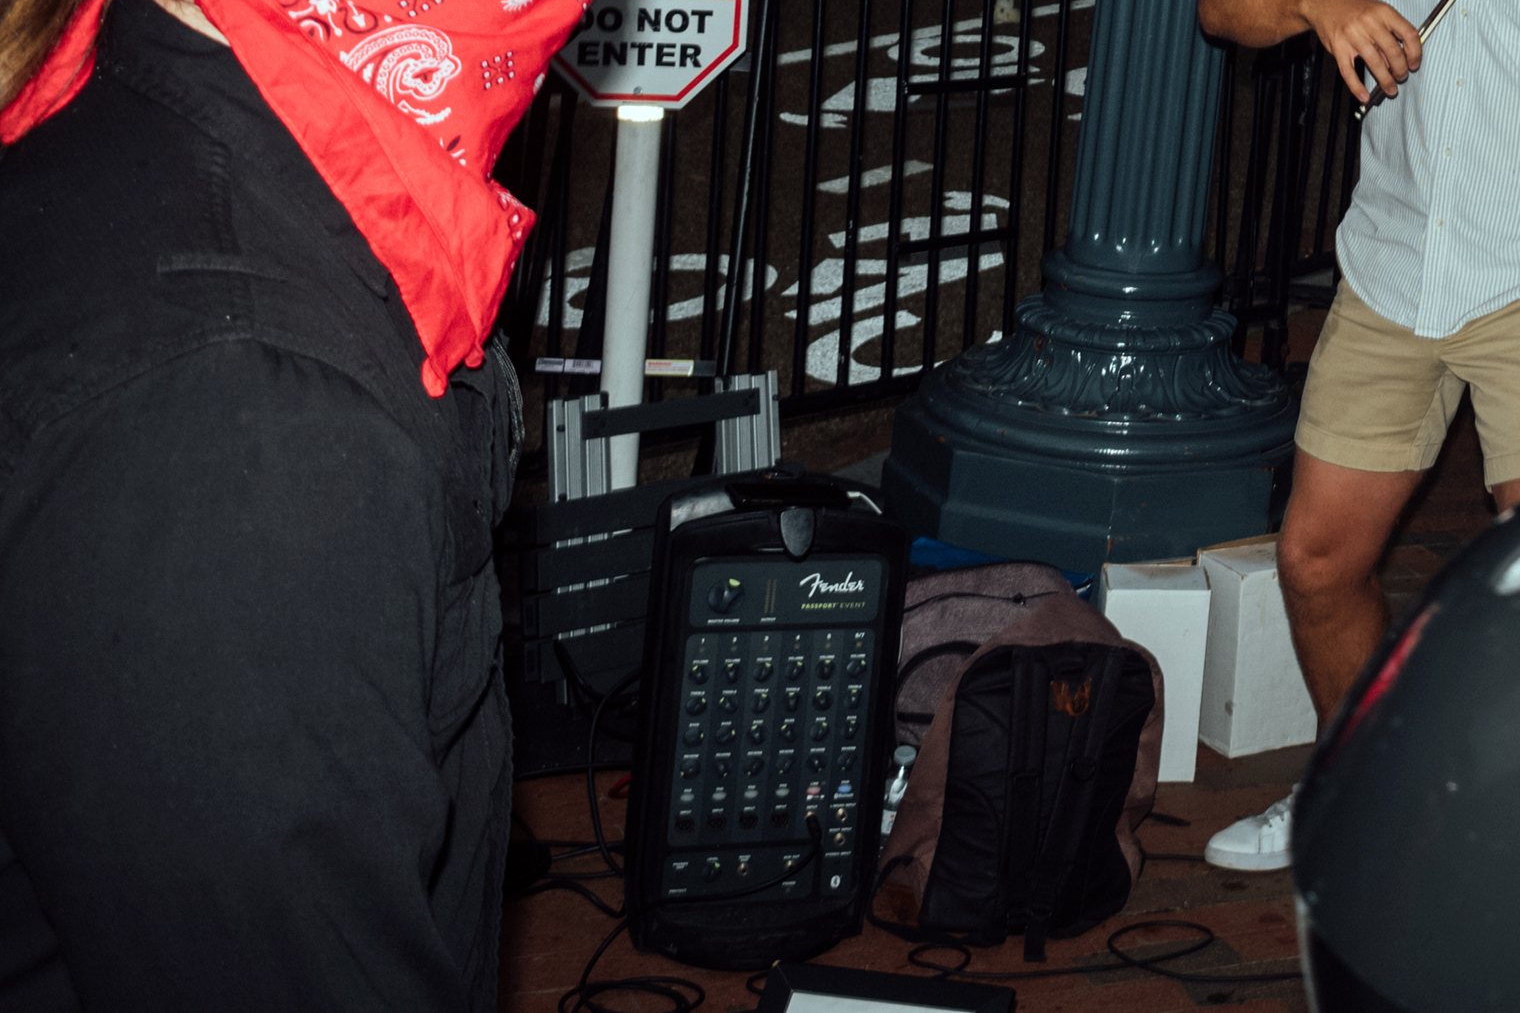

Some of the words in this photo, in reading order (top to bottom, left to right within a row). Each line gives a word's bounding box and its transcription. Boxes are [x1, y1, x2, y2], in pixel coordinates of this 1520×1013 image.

[636, 7, 714, 34] NOT
[576, 41, 703, 68] ENTER
[799, 571, 865, 599] Fender
[839, 601, 866, 609] EVENT
